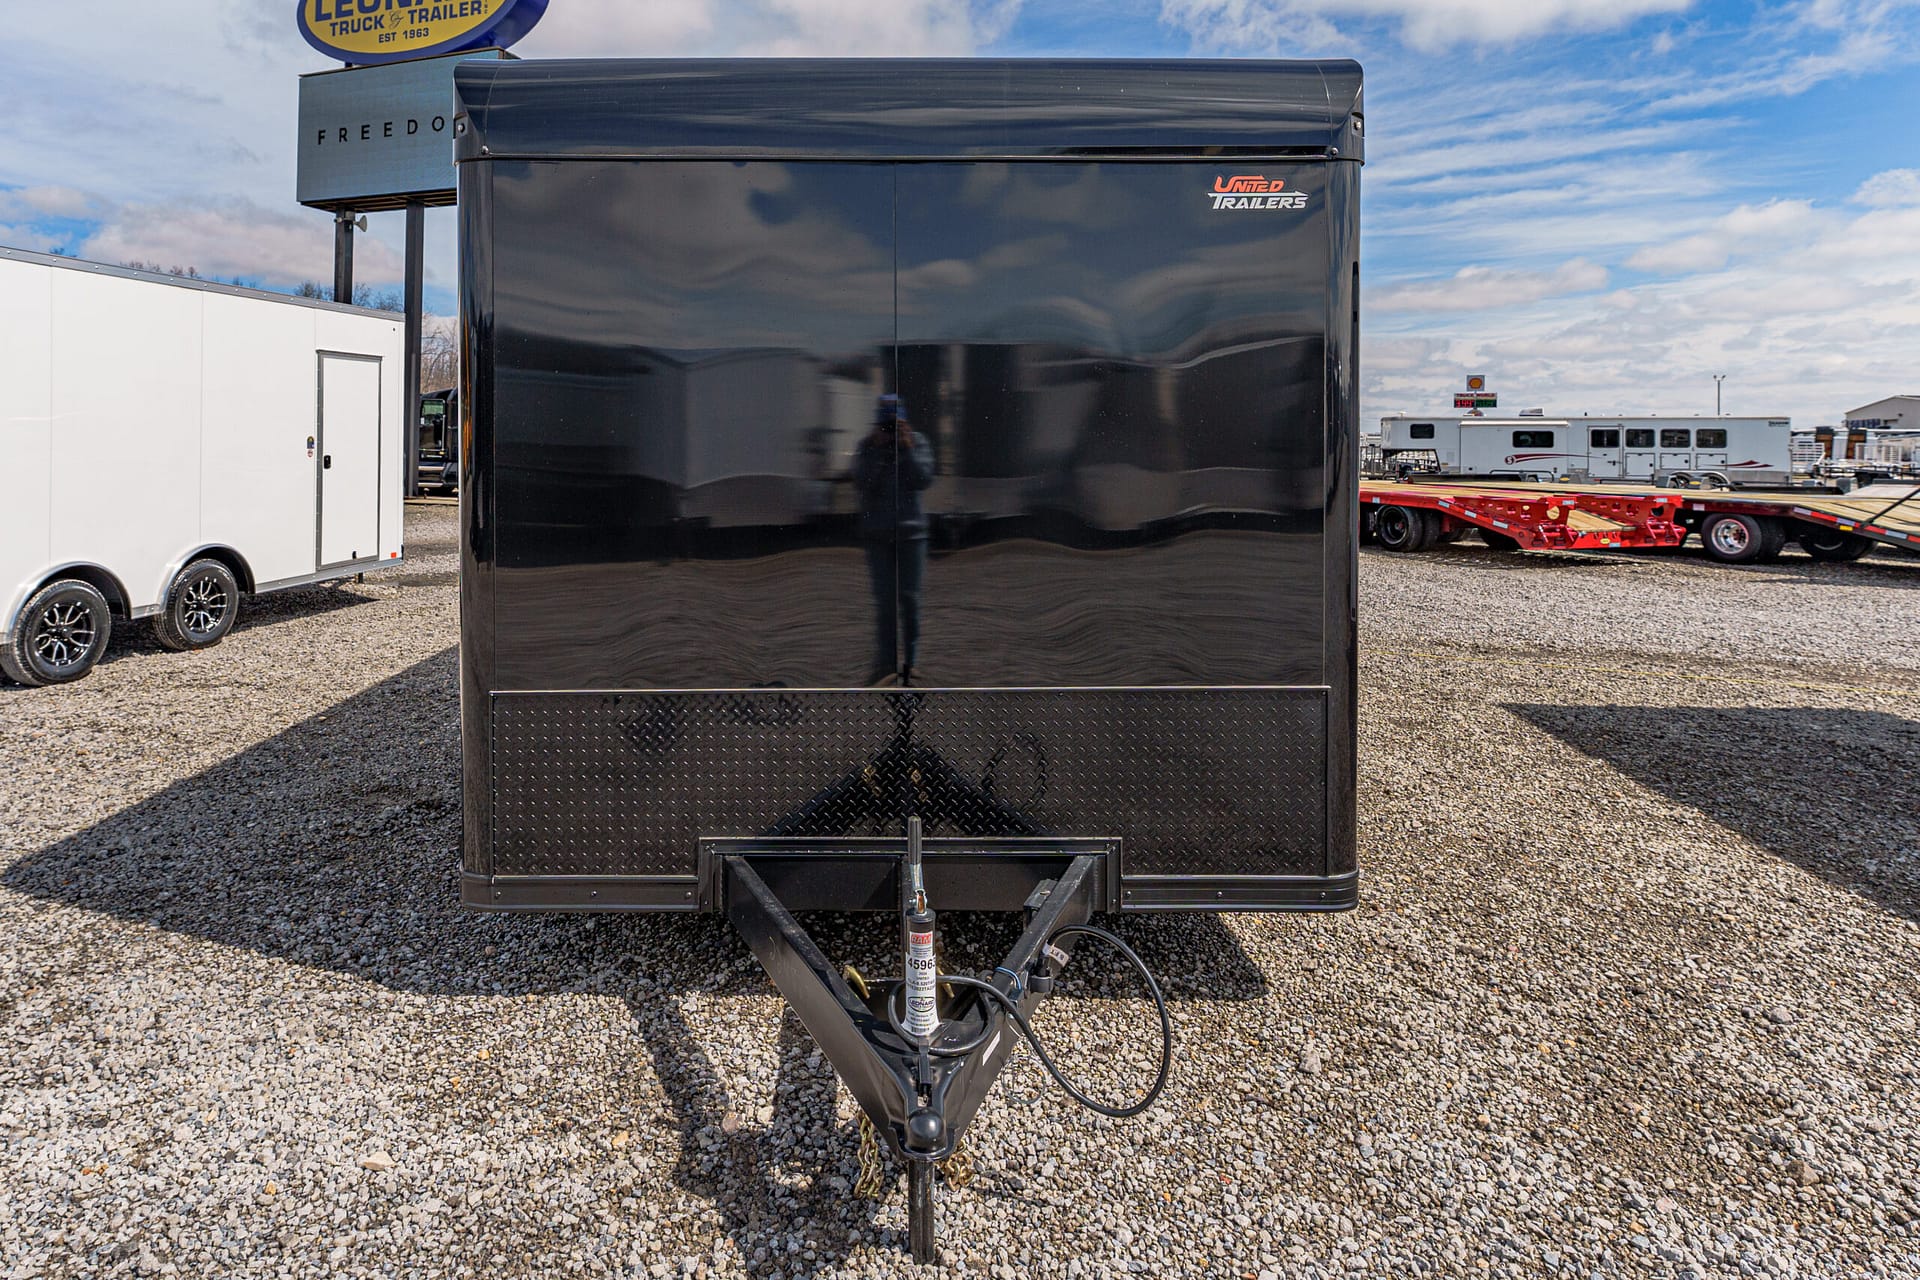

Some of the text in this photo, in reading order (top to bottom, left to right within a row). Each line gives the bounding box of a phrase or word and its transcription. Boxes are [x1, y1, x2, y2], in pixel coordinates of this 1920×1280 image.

[330, 14, 385, 37] TRUCK
[407, 0, 482, 25] TRAILER
[378, 28, 430, 43] EST 1963
[1214, 175, 1285, 193] UNITED
[1207, 190, 1308, 209] TRAILERS
